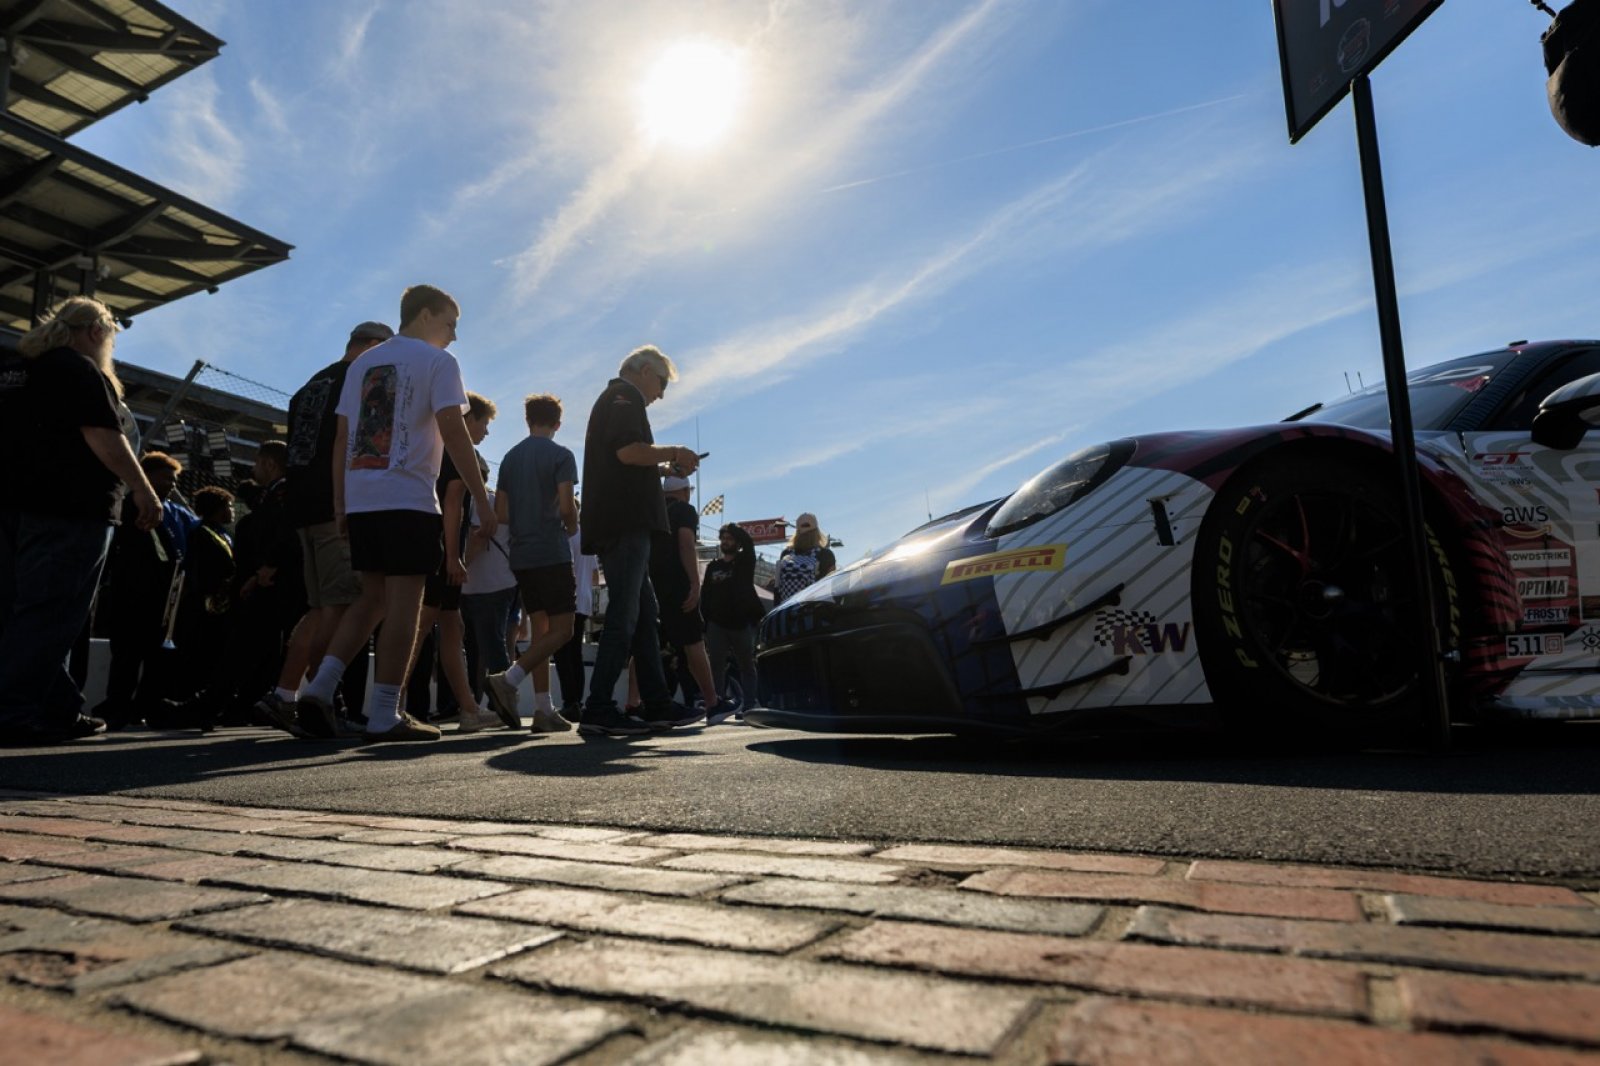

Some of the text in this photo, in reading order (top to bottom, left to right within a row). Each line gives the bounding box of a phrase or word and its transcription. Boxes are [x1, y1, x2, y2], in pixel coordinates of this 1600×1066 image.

[1473, 452, 1531, 464] GT
[1503, 505, 1548, 522] aws
[951, 548, 1056, 578] PIRELLI
[1215, 535, 1243, 639] ZERO
[1518, 580, 1566, 595] OPTIMA
[1528, 608, 1569, 619] FROSTY
[1111, 622, 1190, 655] KW
[1508, 636, 1543, 656] 5.11
